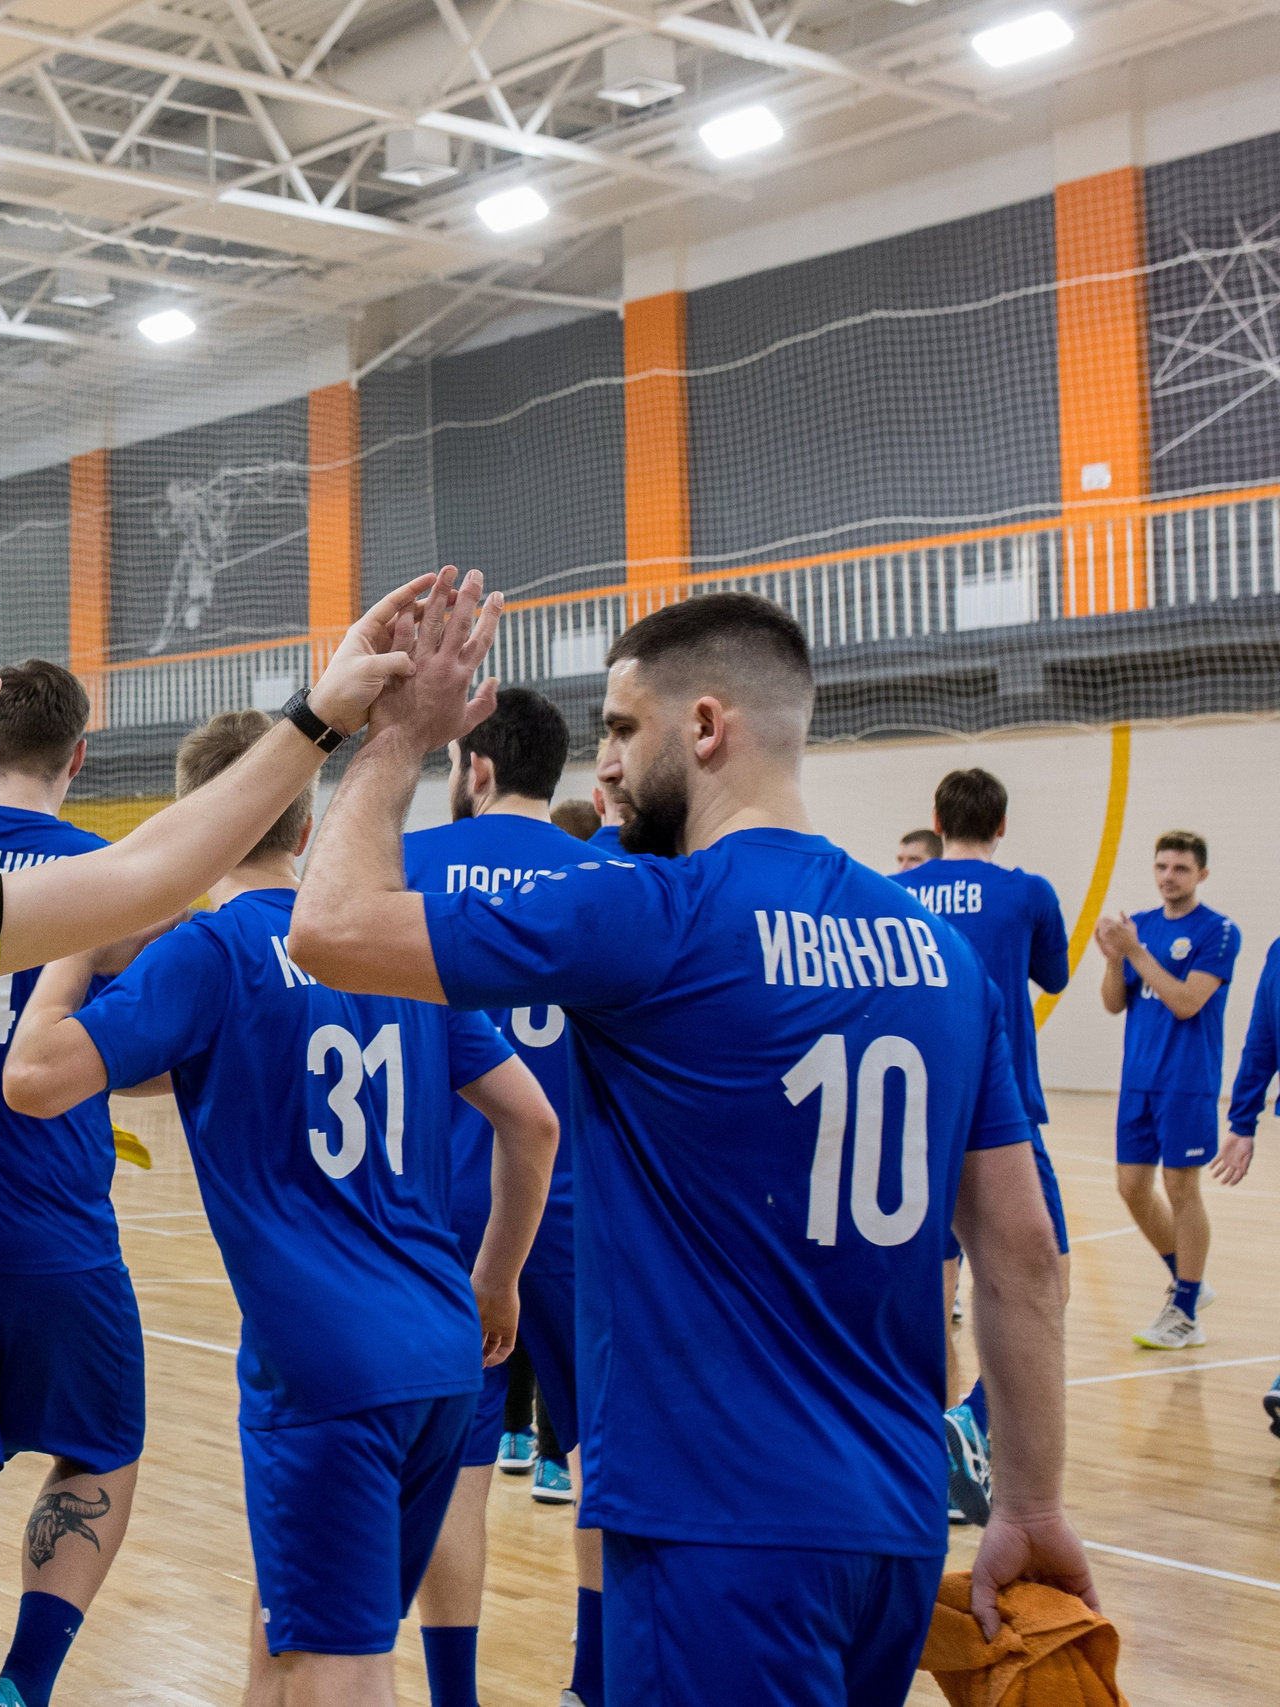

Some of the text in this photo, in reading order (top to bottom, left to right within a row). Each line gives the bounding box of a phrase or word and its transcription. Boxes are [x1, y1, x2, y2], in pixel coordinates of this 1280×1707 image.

[754, 910, 949, 989] ИВАНОВ
[906, 880, 982, 914] ИЛЁВ
[307, 1023, 405, 1180] 31
[781, 1033, 929, 1247] 10
